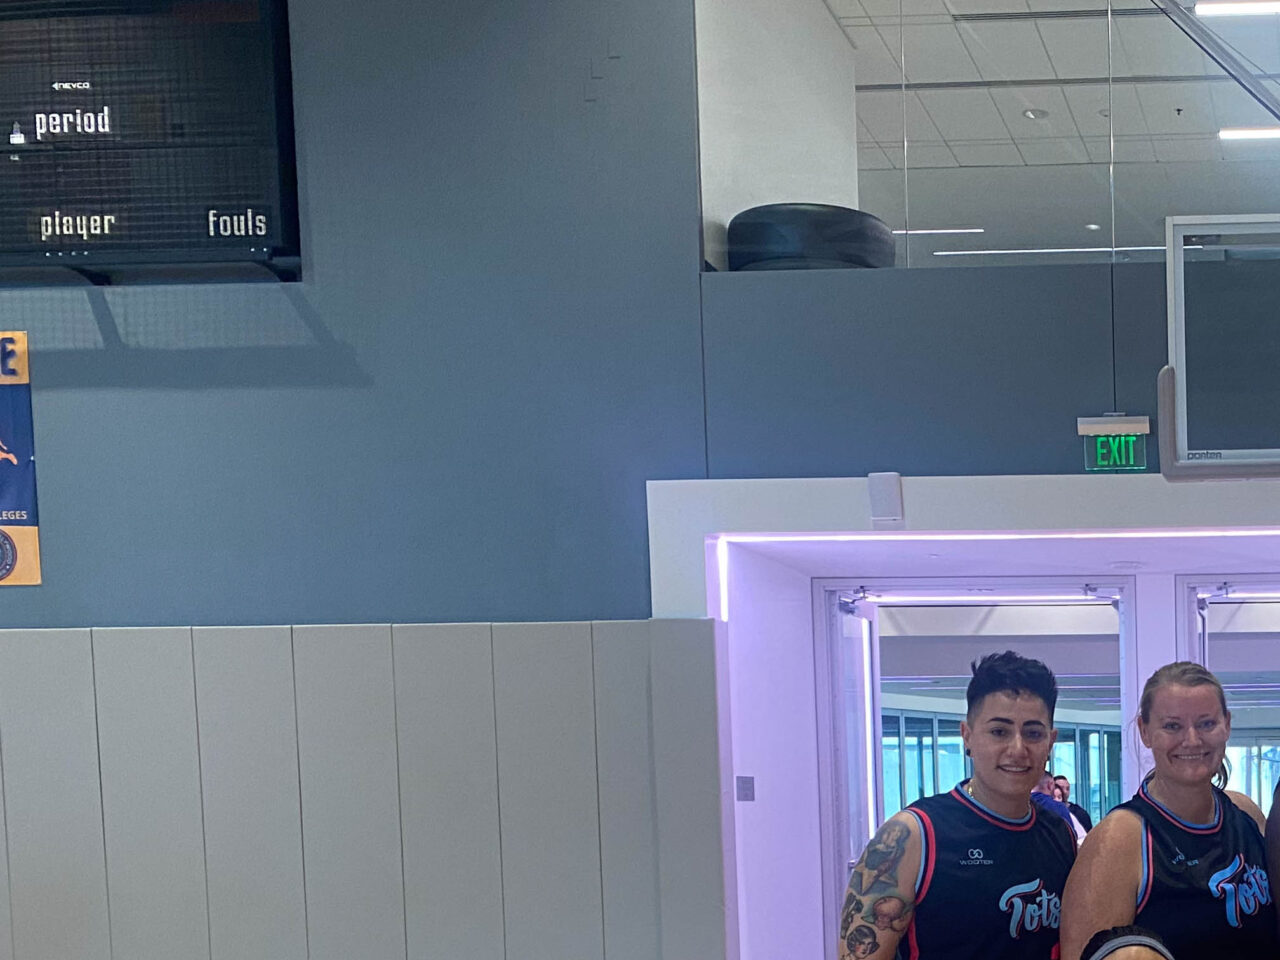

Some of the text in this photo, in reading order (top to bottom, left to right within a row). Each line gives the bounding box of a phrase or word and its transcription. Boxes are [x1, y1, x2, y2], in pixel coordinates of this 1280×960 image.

[35, 106, 110, 141] period
[41, 211, 115, 241] player
[1096, 436, 1137, 466] EXIT
[999, 877, 1063, 939] Tots
[1208, 853, 1273, 929] Tots
